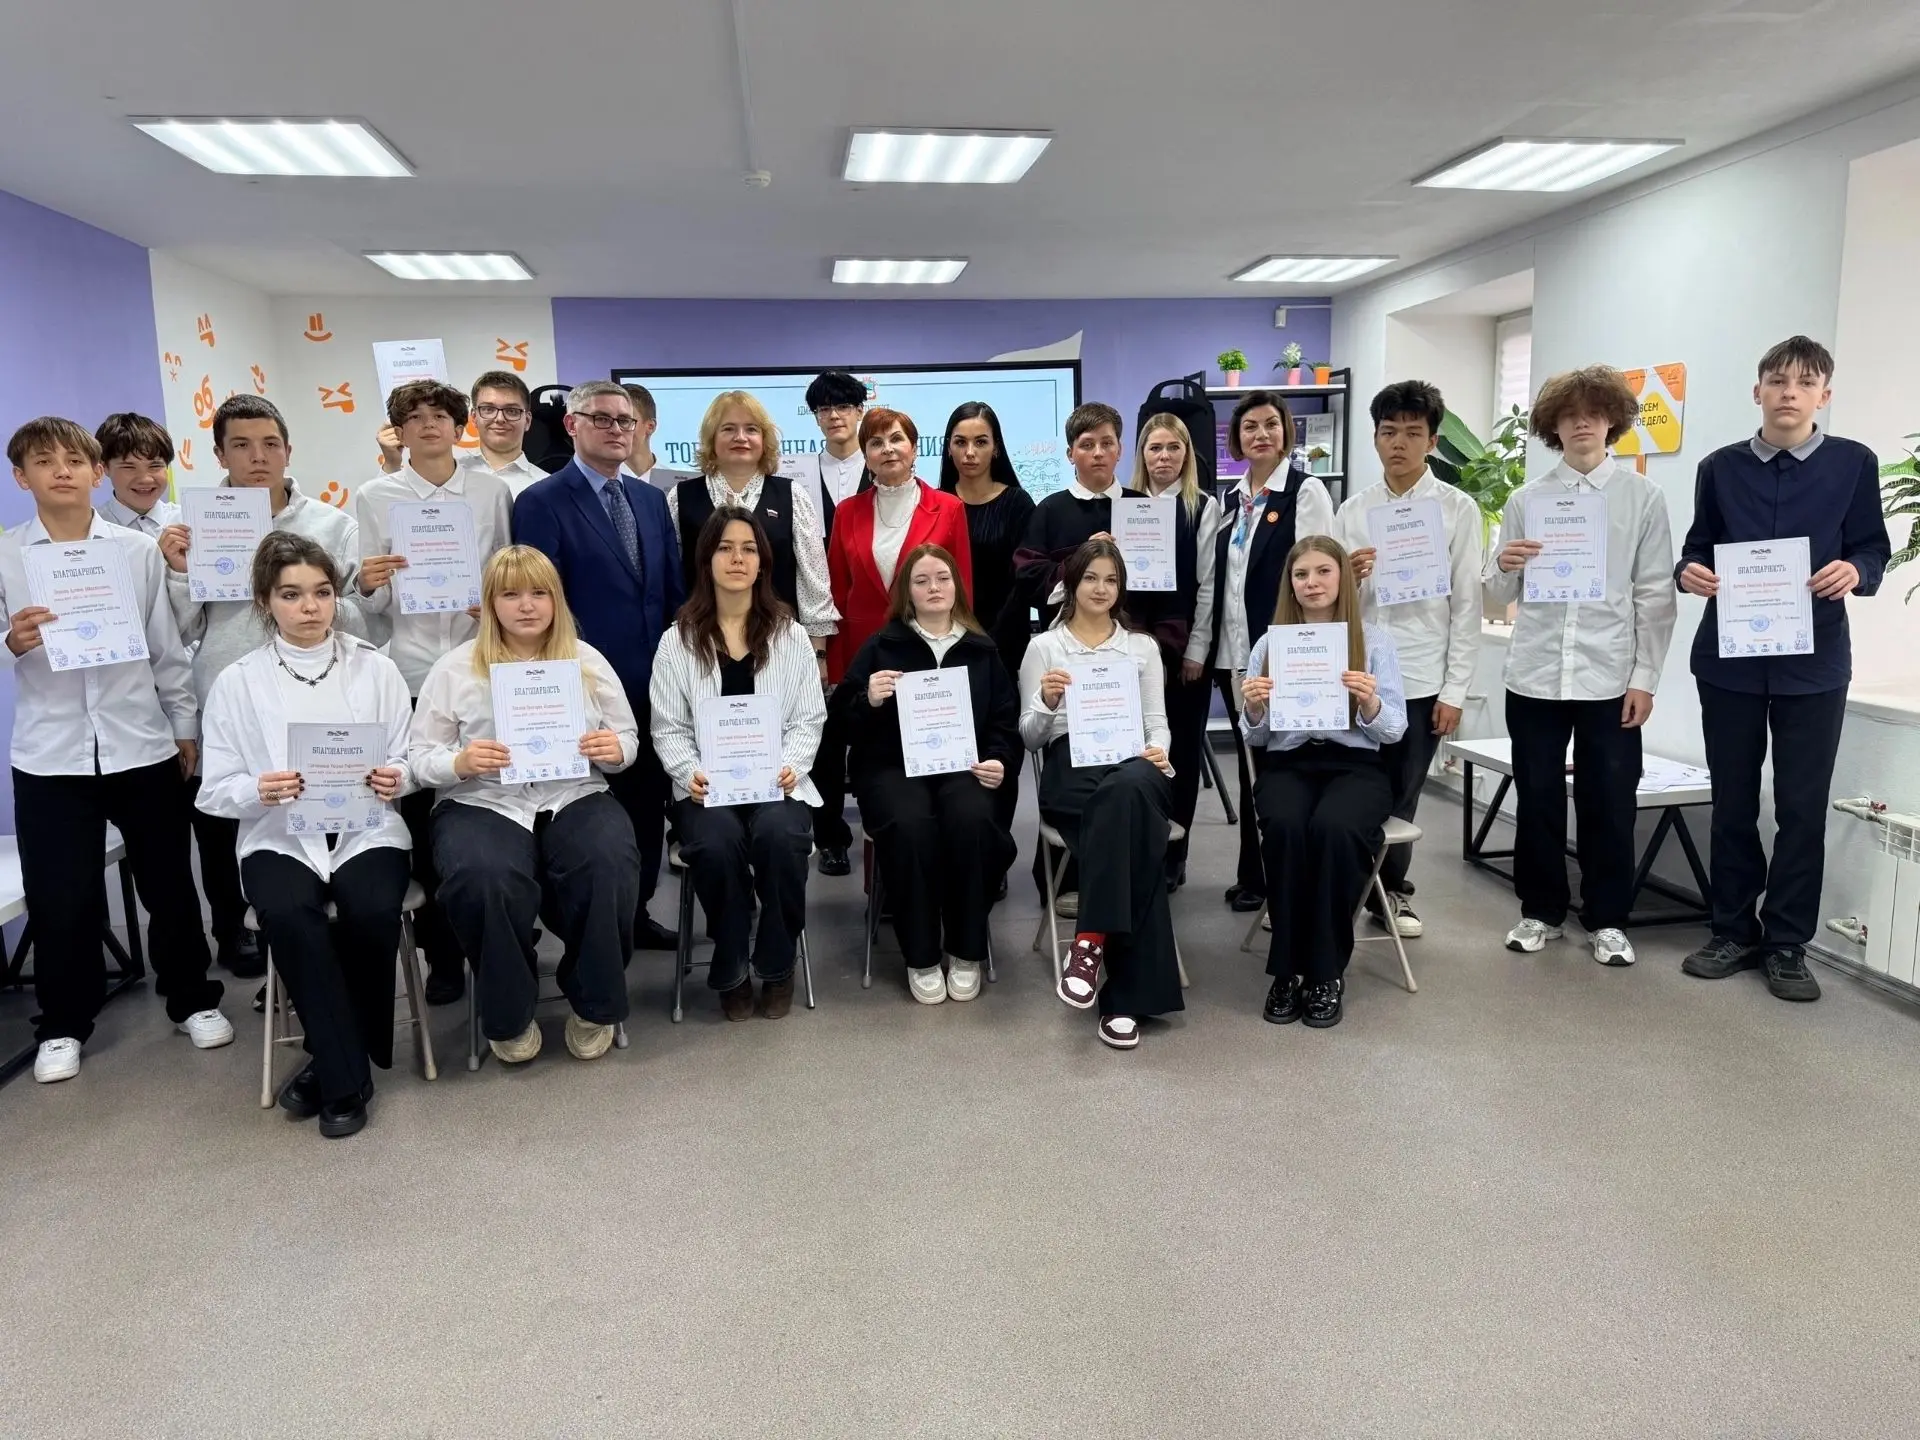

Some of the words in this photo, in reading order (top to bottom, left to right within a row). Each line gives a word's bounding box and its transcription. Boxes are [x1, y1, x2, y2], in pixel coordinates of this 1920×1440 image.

[1647, 414, 1668, 427] ДЕЛО
[204, 511, 250, 519] БЛАГОДАРНОСТЬ
[1544, 516, 1587, 525] БЛАГОДАРНОСТЬ
[53, 566, 105, 579] БЛАГОДАРНОСТЬ
[1737, 564, 1787, 575] БЛАГОДАРНОСТЬ
[1287, 645, 1328, 654] БЛАГОДАРНОСТЬ
[514, 685, 560, 696] БЛАГОДАРНОСТЬ
[1082, 681, 1120, 691] БЛАГОДАРНОСТЬ
[312, 746, 364, 755] БЛАГОДАРНОСТЬ
